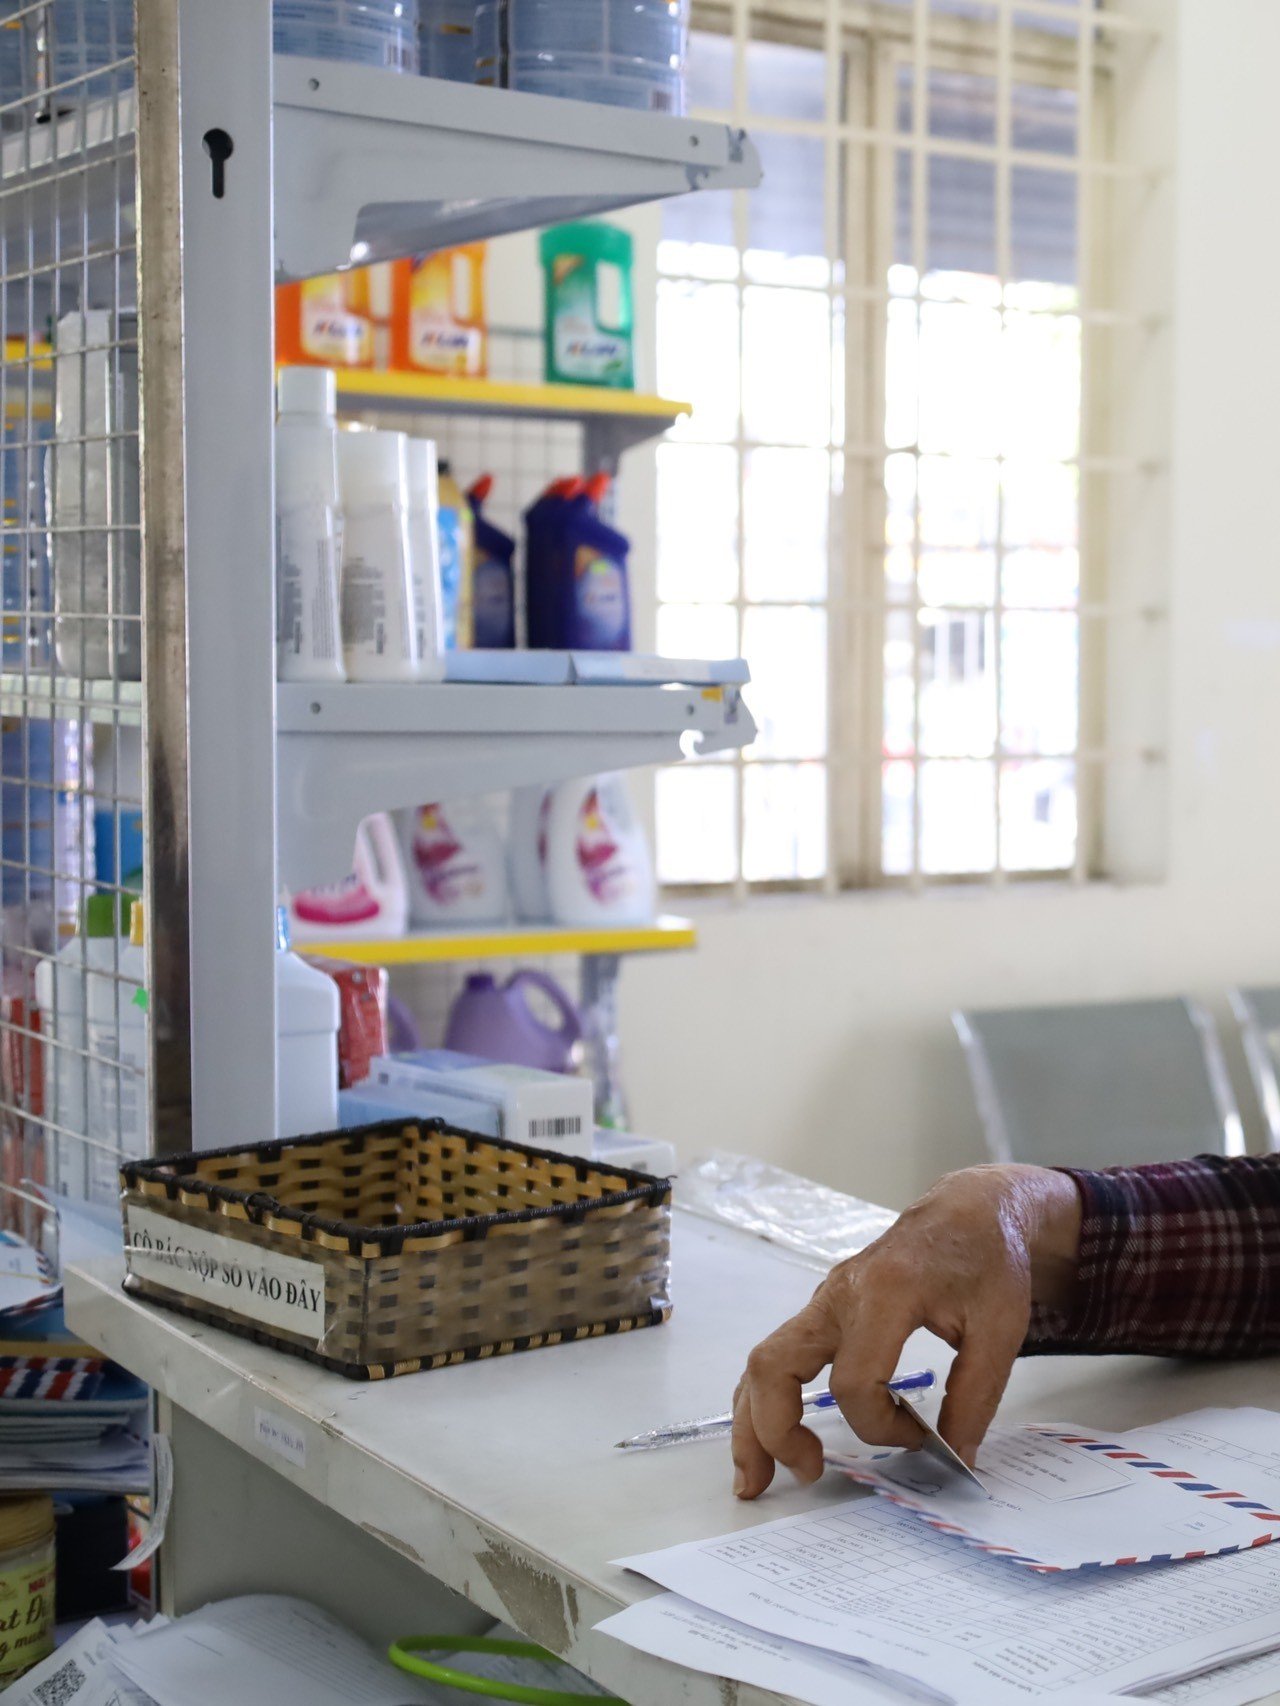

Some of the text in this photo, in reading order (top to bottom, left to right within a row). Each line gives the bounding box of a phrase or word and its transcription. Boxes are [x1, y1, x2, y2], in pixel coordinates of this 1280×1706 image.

[187, 1251, 219, 1283] NỘP
[245, 1266, 282, 1301] VÀO
[285, 1279, 322, 1313] ĐÂY
